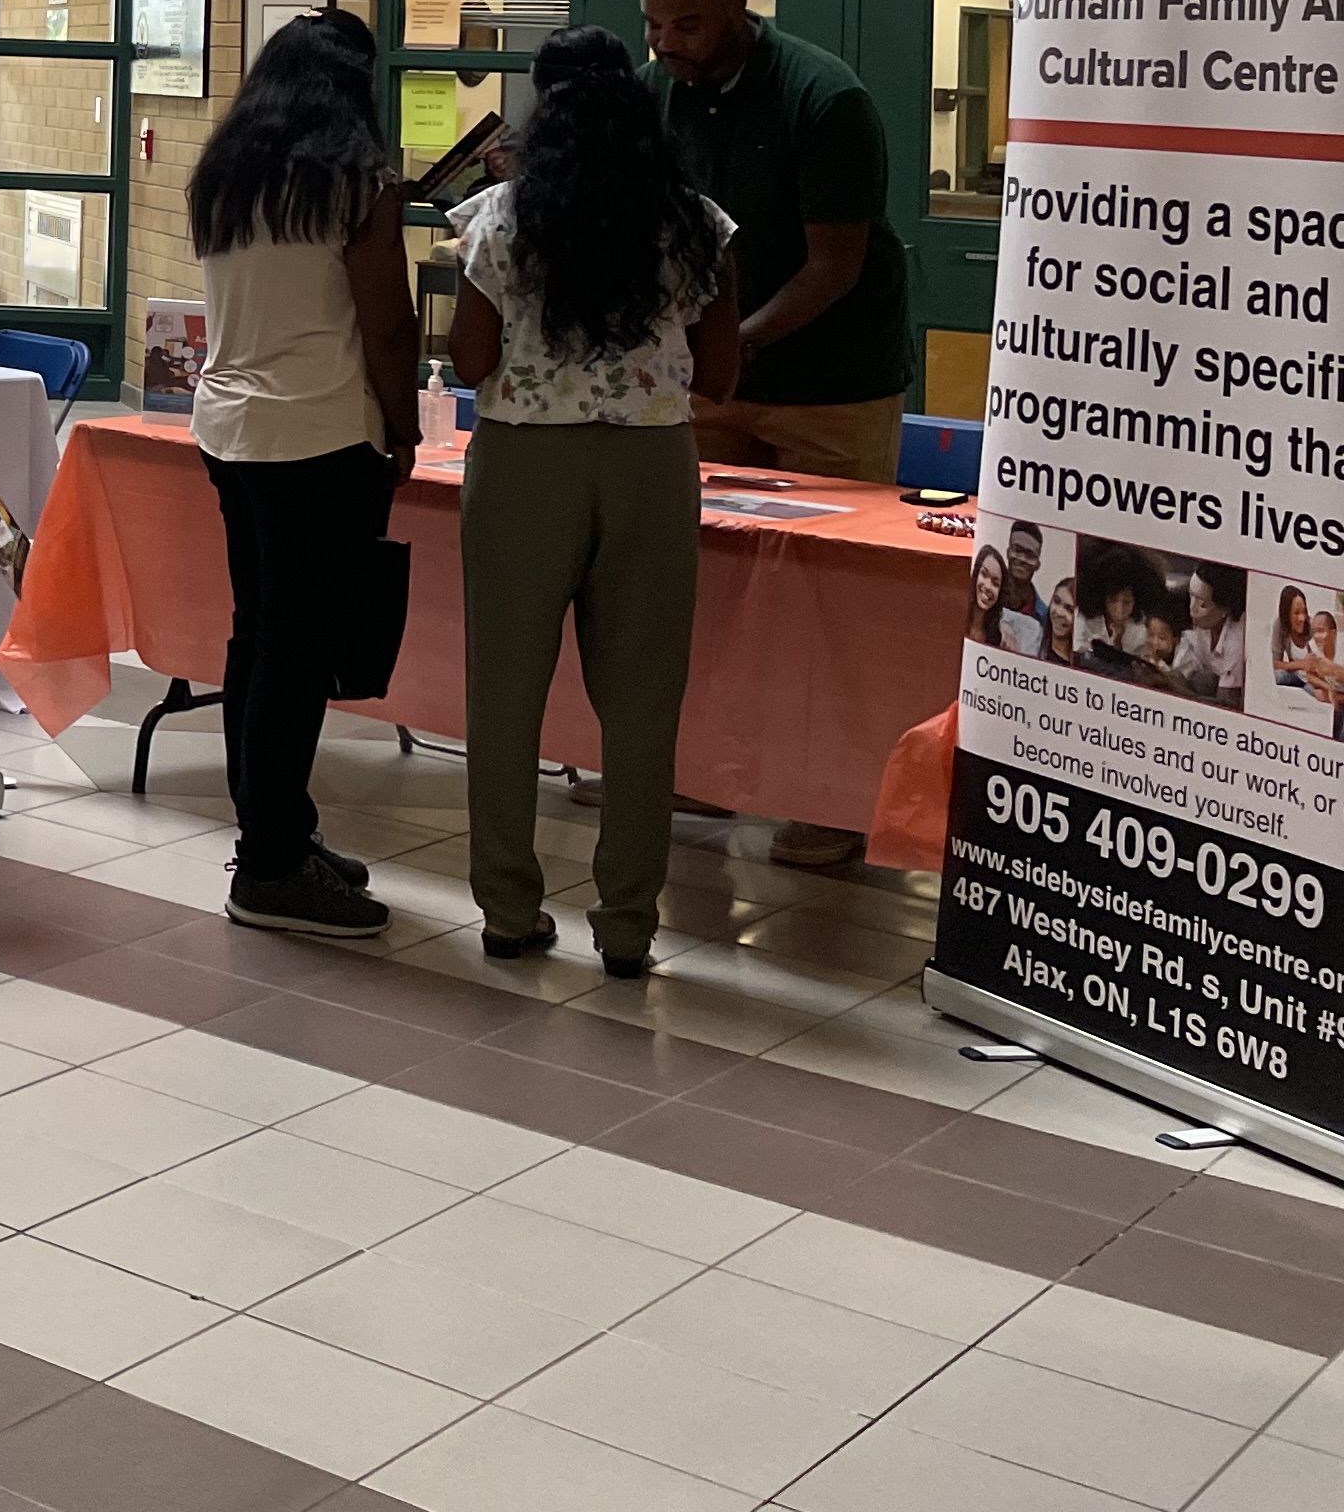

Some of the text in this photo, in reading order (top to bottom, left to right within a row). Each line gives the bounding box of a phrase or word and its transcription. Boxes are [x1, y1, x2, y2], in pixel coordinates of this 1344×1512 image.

[1039, 46, 1337, 94] Cultural Centre
[1004, 176, 1190, 245] Providing
[1206, 202, 1231, 238] a
[1027, 246, 1328, 324] for social and
[995, 315, 1178, 387] culturally
[988, 385, 1272, 477] programming
[996, 454, 1344, 556] empowers lives
[961, 686, 1336, 815] mission, our values and our work, or
[976, 656, 1049, 697] Contact
[1055, 679, 1079, 706] us
[1085, 686, 1105, 712] to
[1110, 692, 1166, 728] learn
[1172, 714, 1229, 745] more
[1236, 726, 1301, 767] about
[1012, 734, 1288, 841] become involved yourself.
[985, 774, 1325, 930] 905 409-0299
[953, 875, 1001, 916] 487
[1007, 893, 1131, 973] Westney
[1141, 946, 1192, 992] Rd.
[1201, 971, 1228, 1010] s,
[1239, 979, 1307, 1035] Unit
[1003, 943, 1289, 1080] Ajax, ON, L1S 6W8
